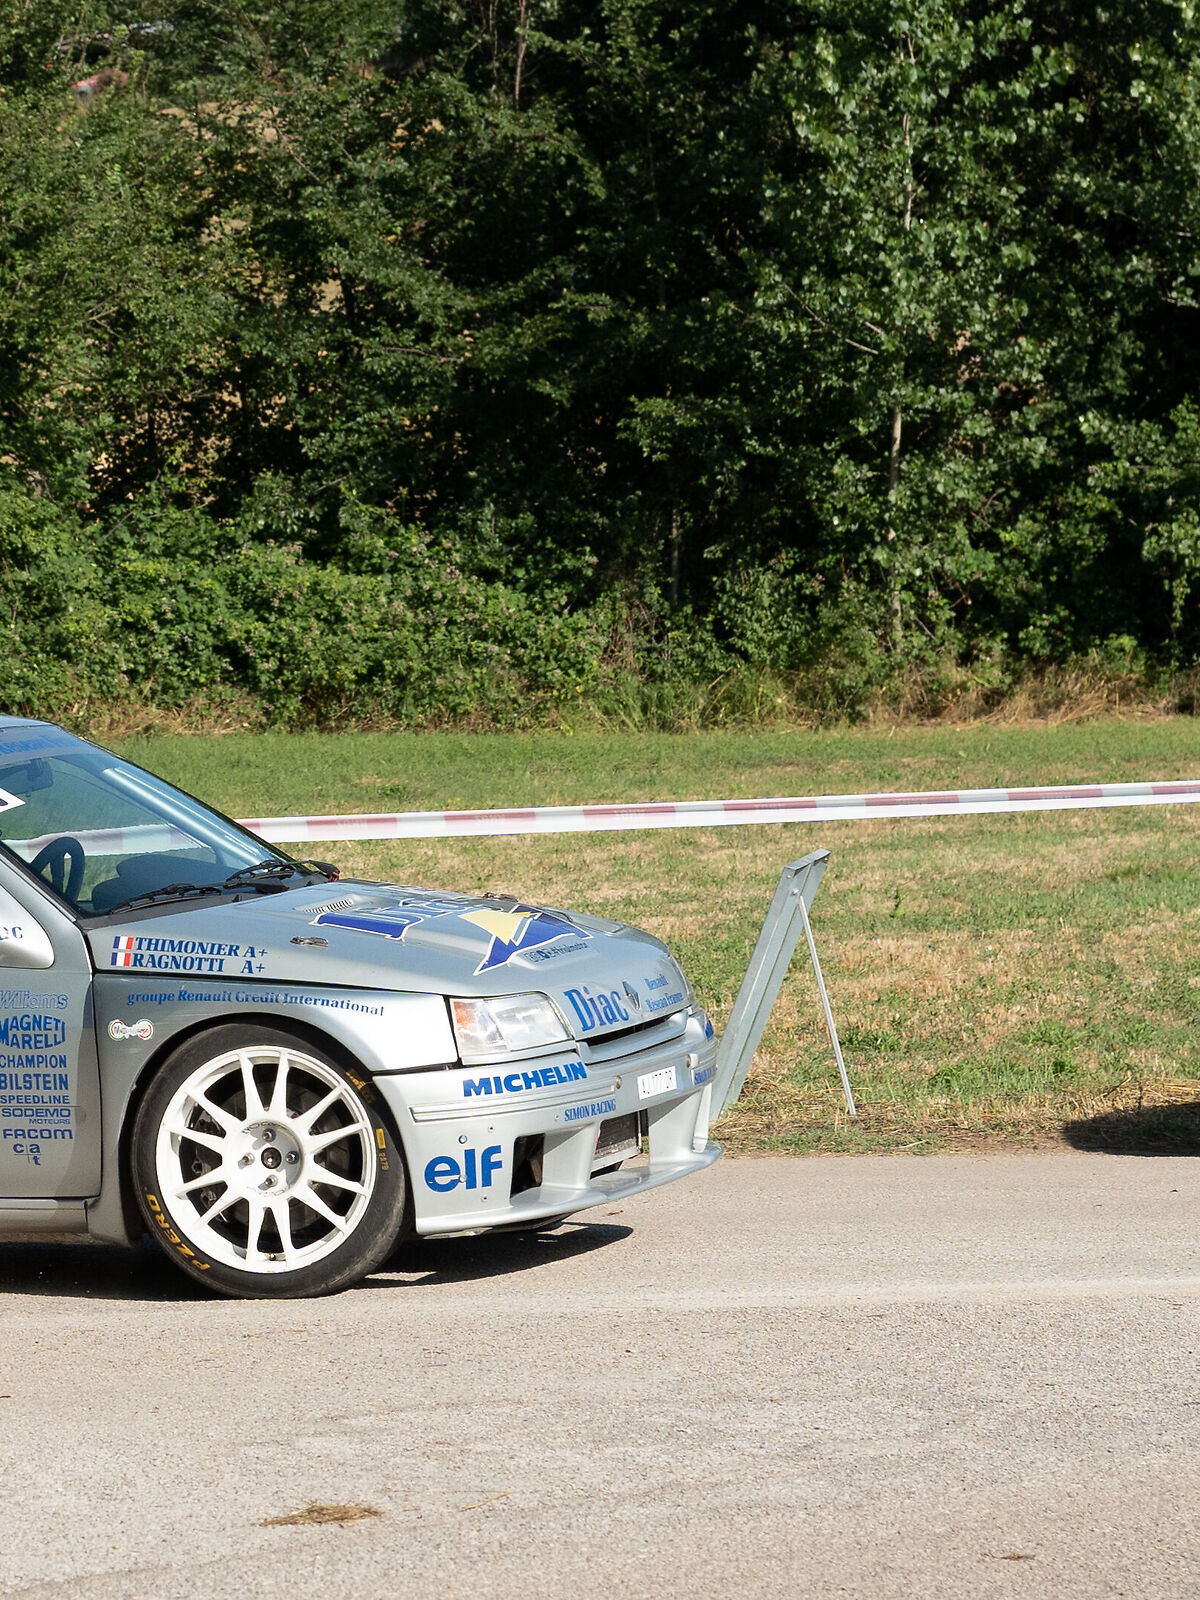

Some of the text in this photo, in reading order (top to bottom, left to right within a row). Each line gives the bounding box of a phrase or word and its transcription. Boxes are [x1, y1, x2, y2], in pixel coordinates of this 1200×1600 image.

[135, 936, 268, 958] THIMONIER A+
[132, 952, 265, 974] RAGNOTTI A+
[127, 989, 385, 1017] groupe Renault Credit International
[563, 985, 630, 1032] Diac
[463, 1062, 588, 1098] MICHELIN
[0, 1094, 71, 1105] SPEEDLINE
[564, 1098, 617, 1122] SIMON RACING
[1, 1108, 72, 1118] SODEMO
[2, 1128, 74, 1140] FACOM
[423, 1145, 503, 1193] elf
[146, 1193, 196, 1259] ZERO
